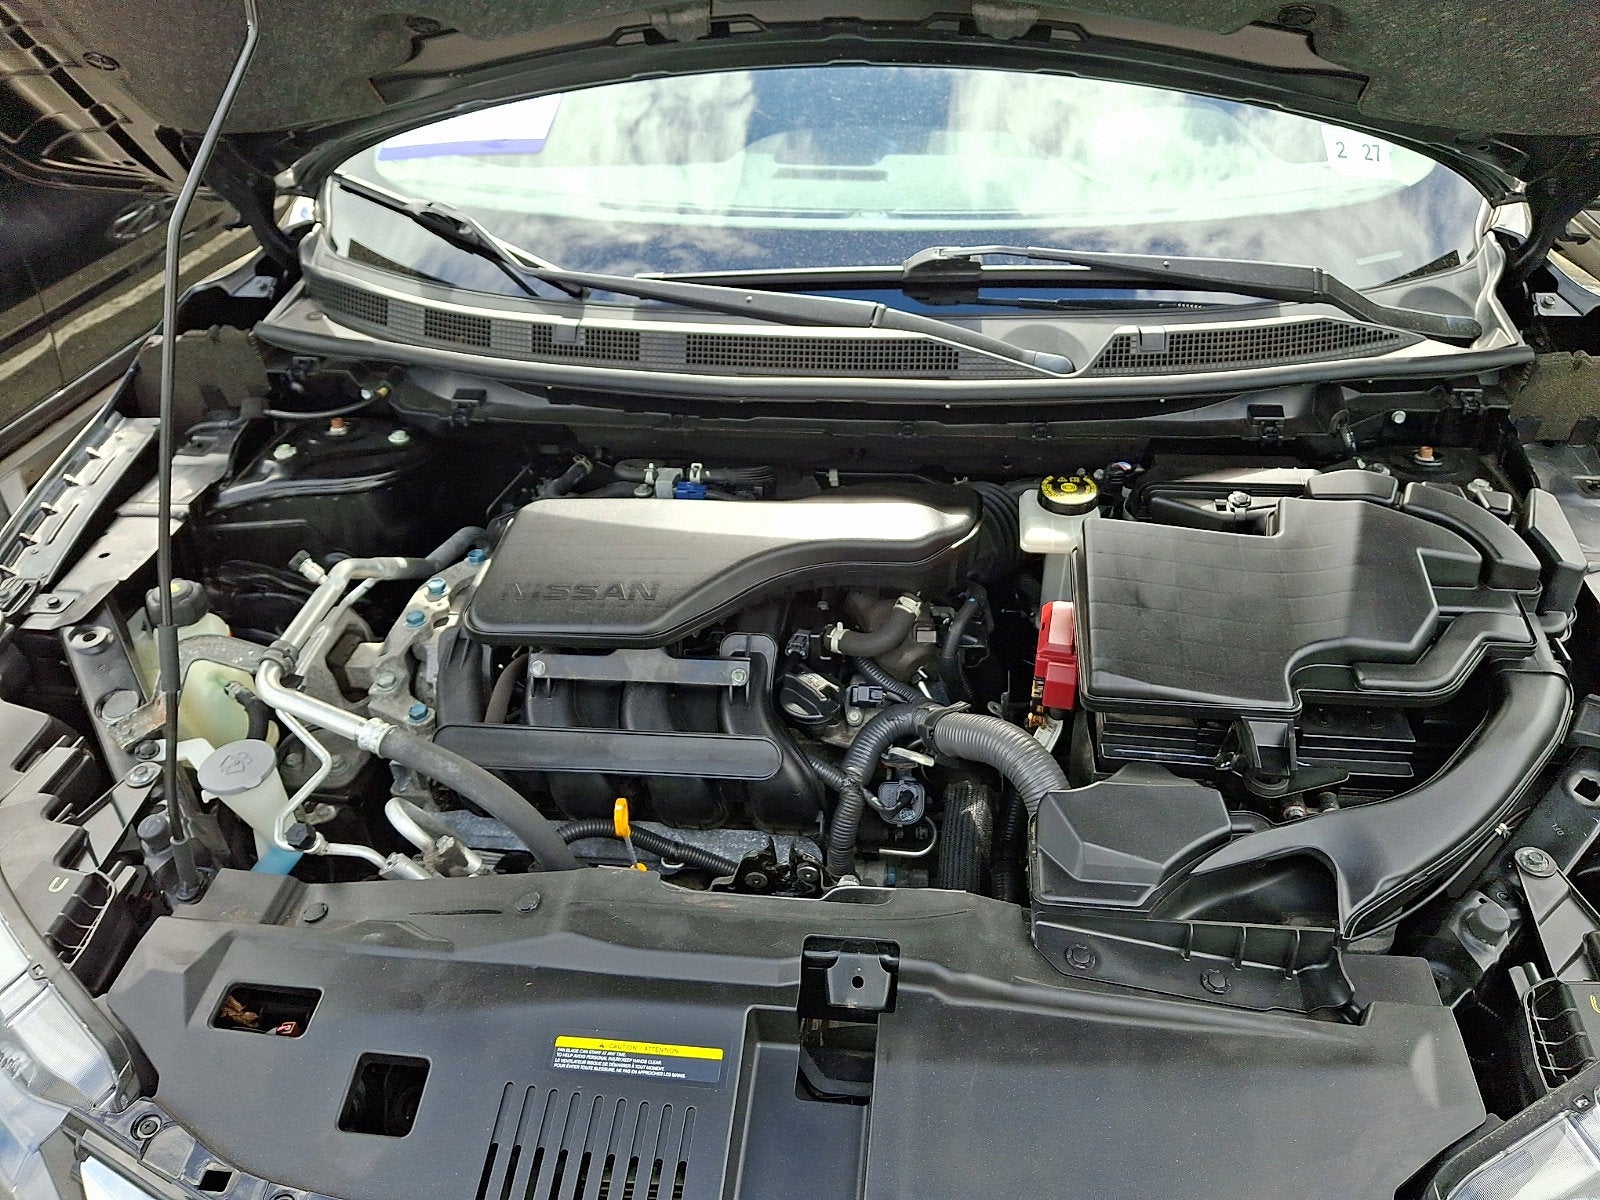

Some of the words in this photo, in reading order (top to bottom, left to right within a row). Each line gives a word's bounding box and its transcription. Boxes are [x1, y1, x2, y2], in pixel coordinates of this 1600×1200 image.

[1336, 141, 1347, 158] 2
[1362, 144, 1380, 161] 27
[501, 582, 661, 600] NISSAN
